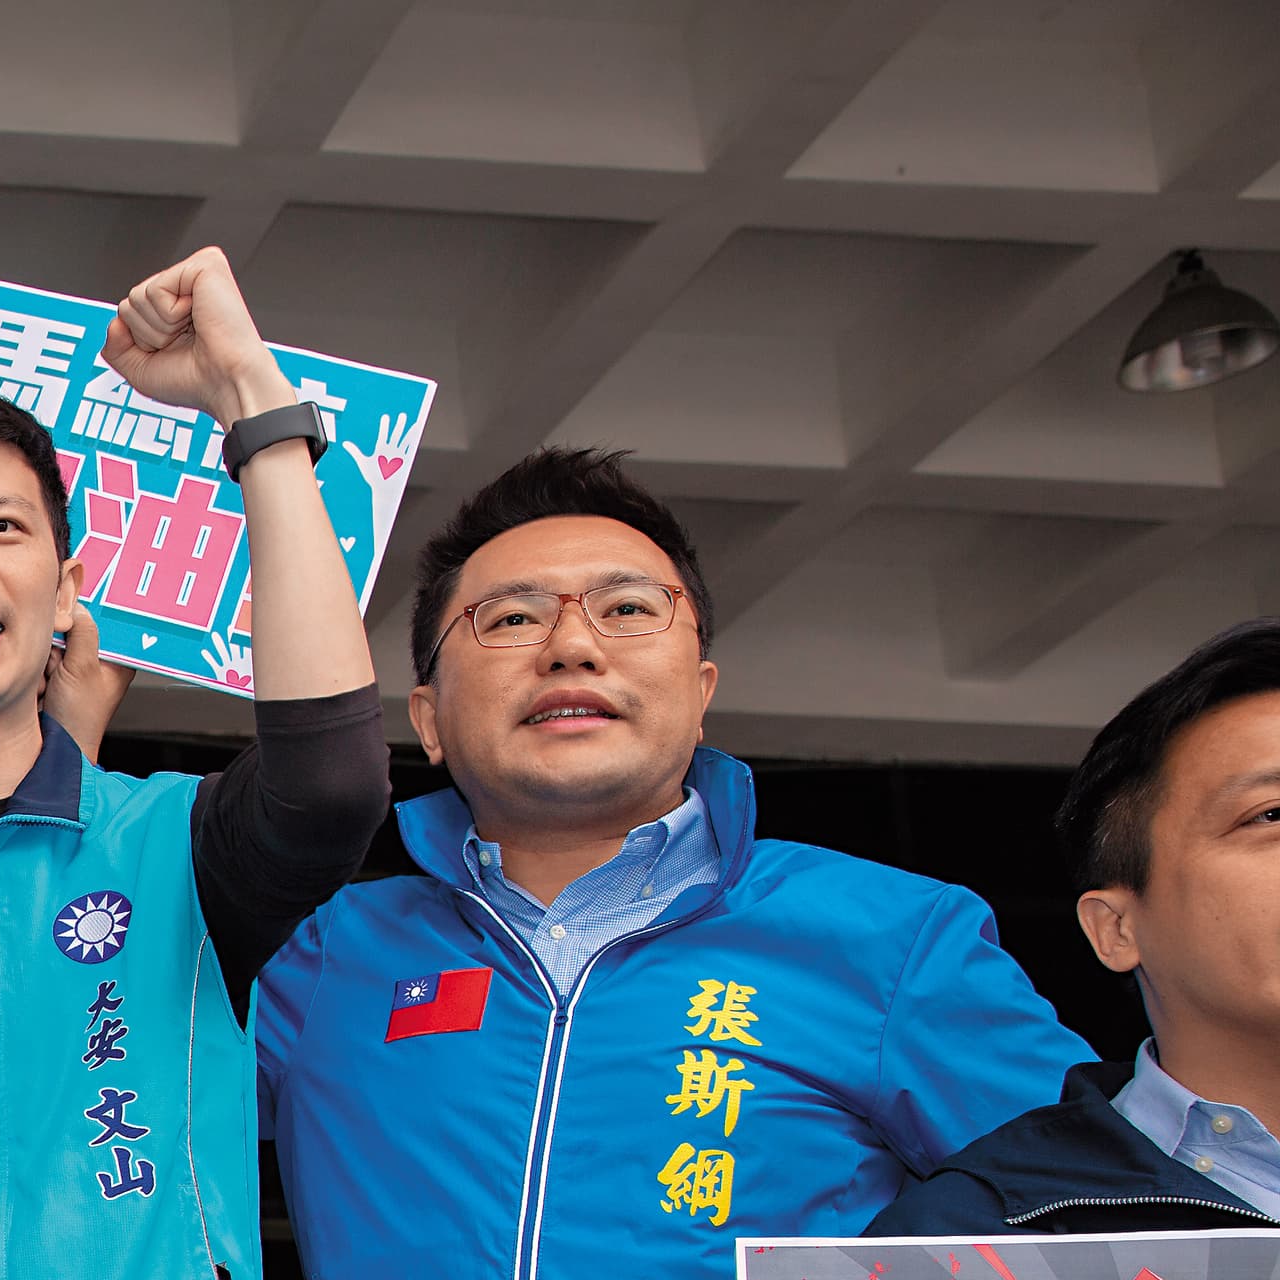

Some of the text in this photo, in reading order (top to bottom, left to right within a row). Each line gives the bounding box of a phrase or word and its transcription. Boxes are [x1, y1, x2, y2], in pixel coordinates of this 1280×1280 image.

[82, 980, 156, 1200] 大安 文山
[657, 978, 762, 1227] 張斯綱
